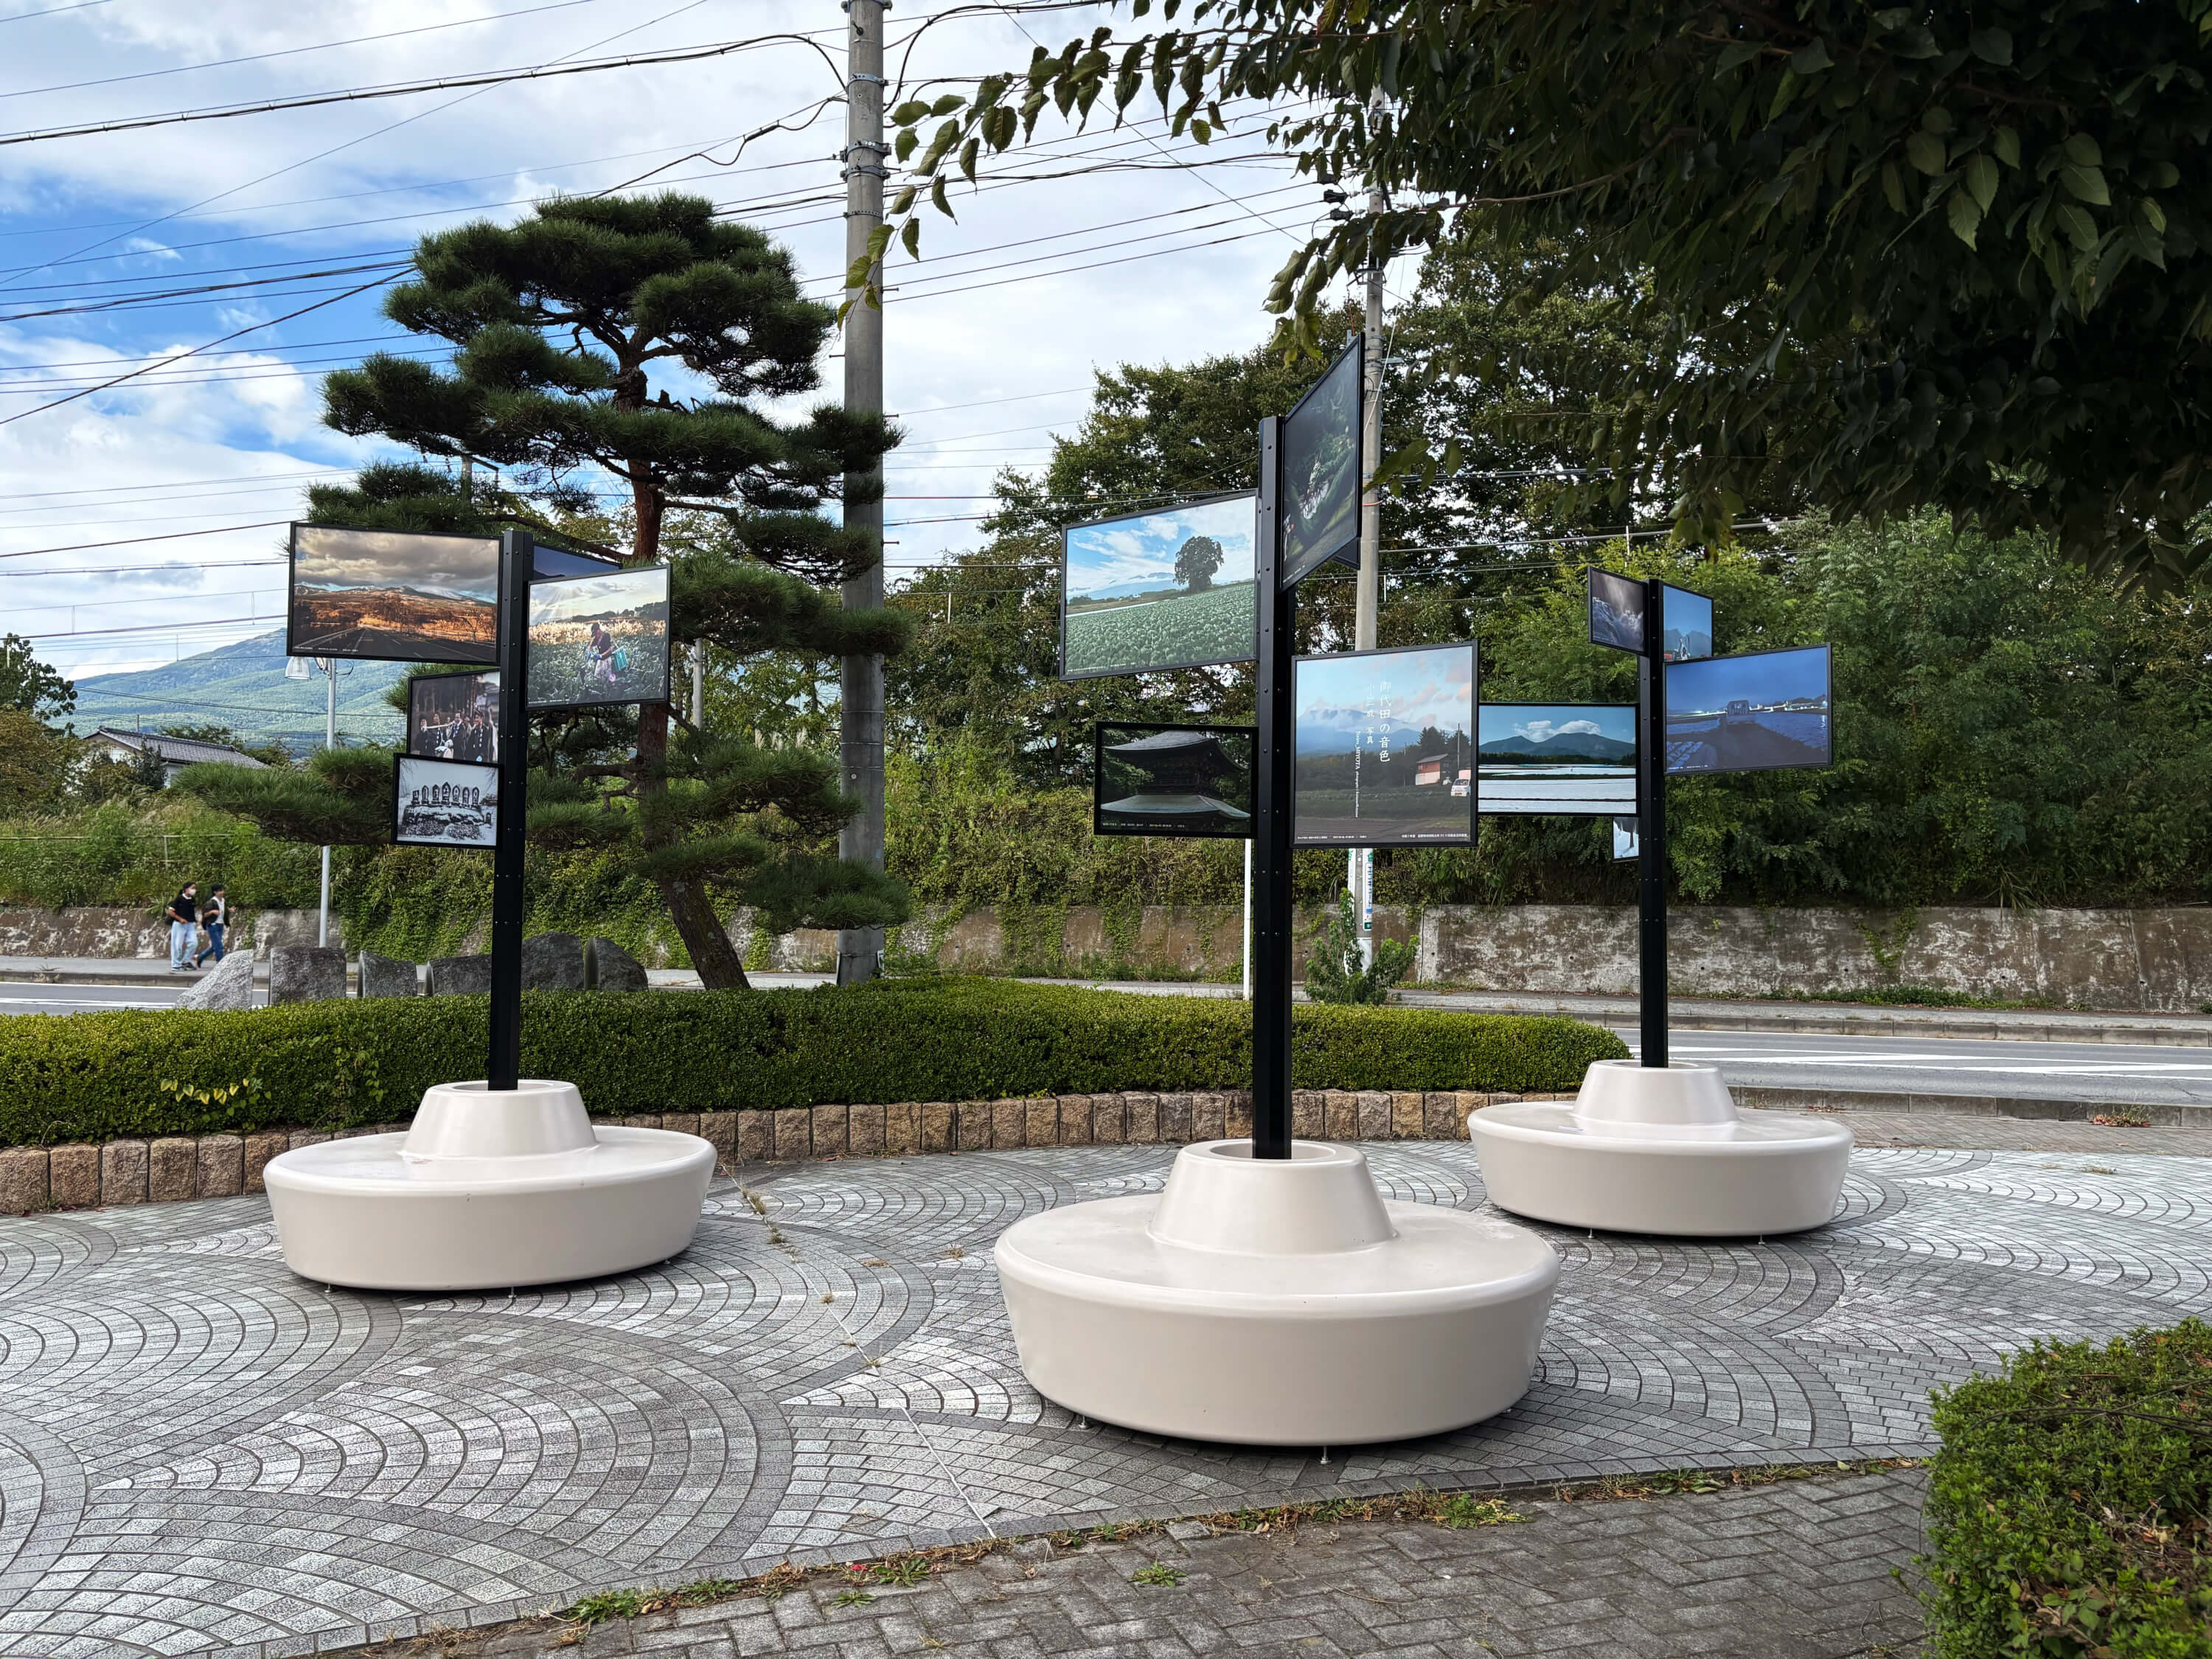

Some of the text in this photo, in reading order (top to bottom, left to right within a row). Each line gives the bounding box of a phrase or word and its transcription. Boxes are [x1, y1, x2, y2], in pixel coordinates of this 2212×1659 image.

[1379, 680, 1392, 762] 御代田の音色
